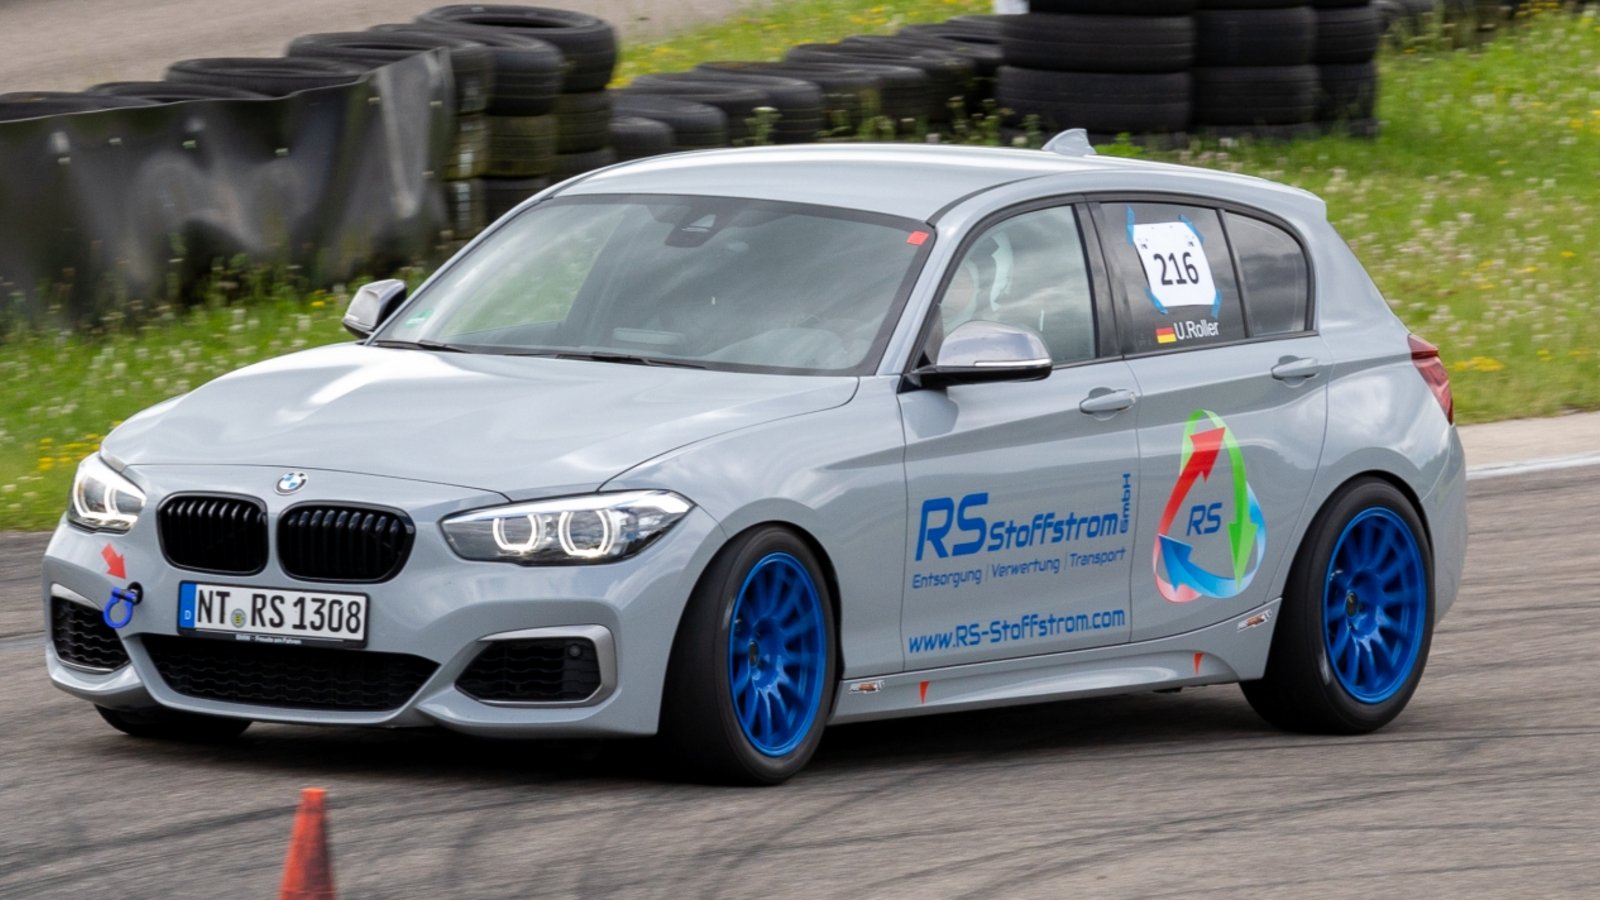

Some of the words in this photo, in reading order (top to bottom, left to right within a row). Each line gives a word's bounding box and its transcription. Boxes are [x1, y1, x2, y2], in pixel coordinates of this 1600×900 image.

[1153, 252, 1200, 286] 216
[1173, 319, 1219, 340] U.Roller
[1119, 472, 1132, 534] GmbH
[1186, 502, 1223, 536] RS
[914, 492, 989, 561] RS
[987, 512, 1118, 552] Stoffstrom
[912, 569, 982, 588] Entsorgung
[991, 558, 1060, 578] Verwertung
[1069, 547, 1126, 568] Transport
[197, 589, 231, 624] NT
[251, 593, 285, 628] RS
[292, 597, 361, 634] 1308
[908, 609, 1126, 653] www.RS-Stoffstrom.com
